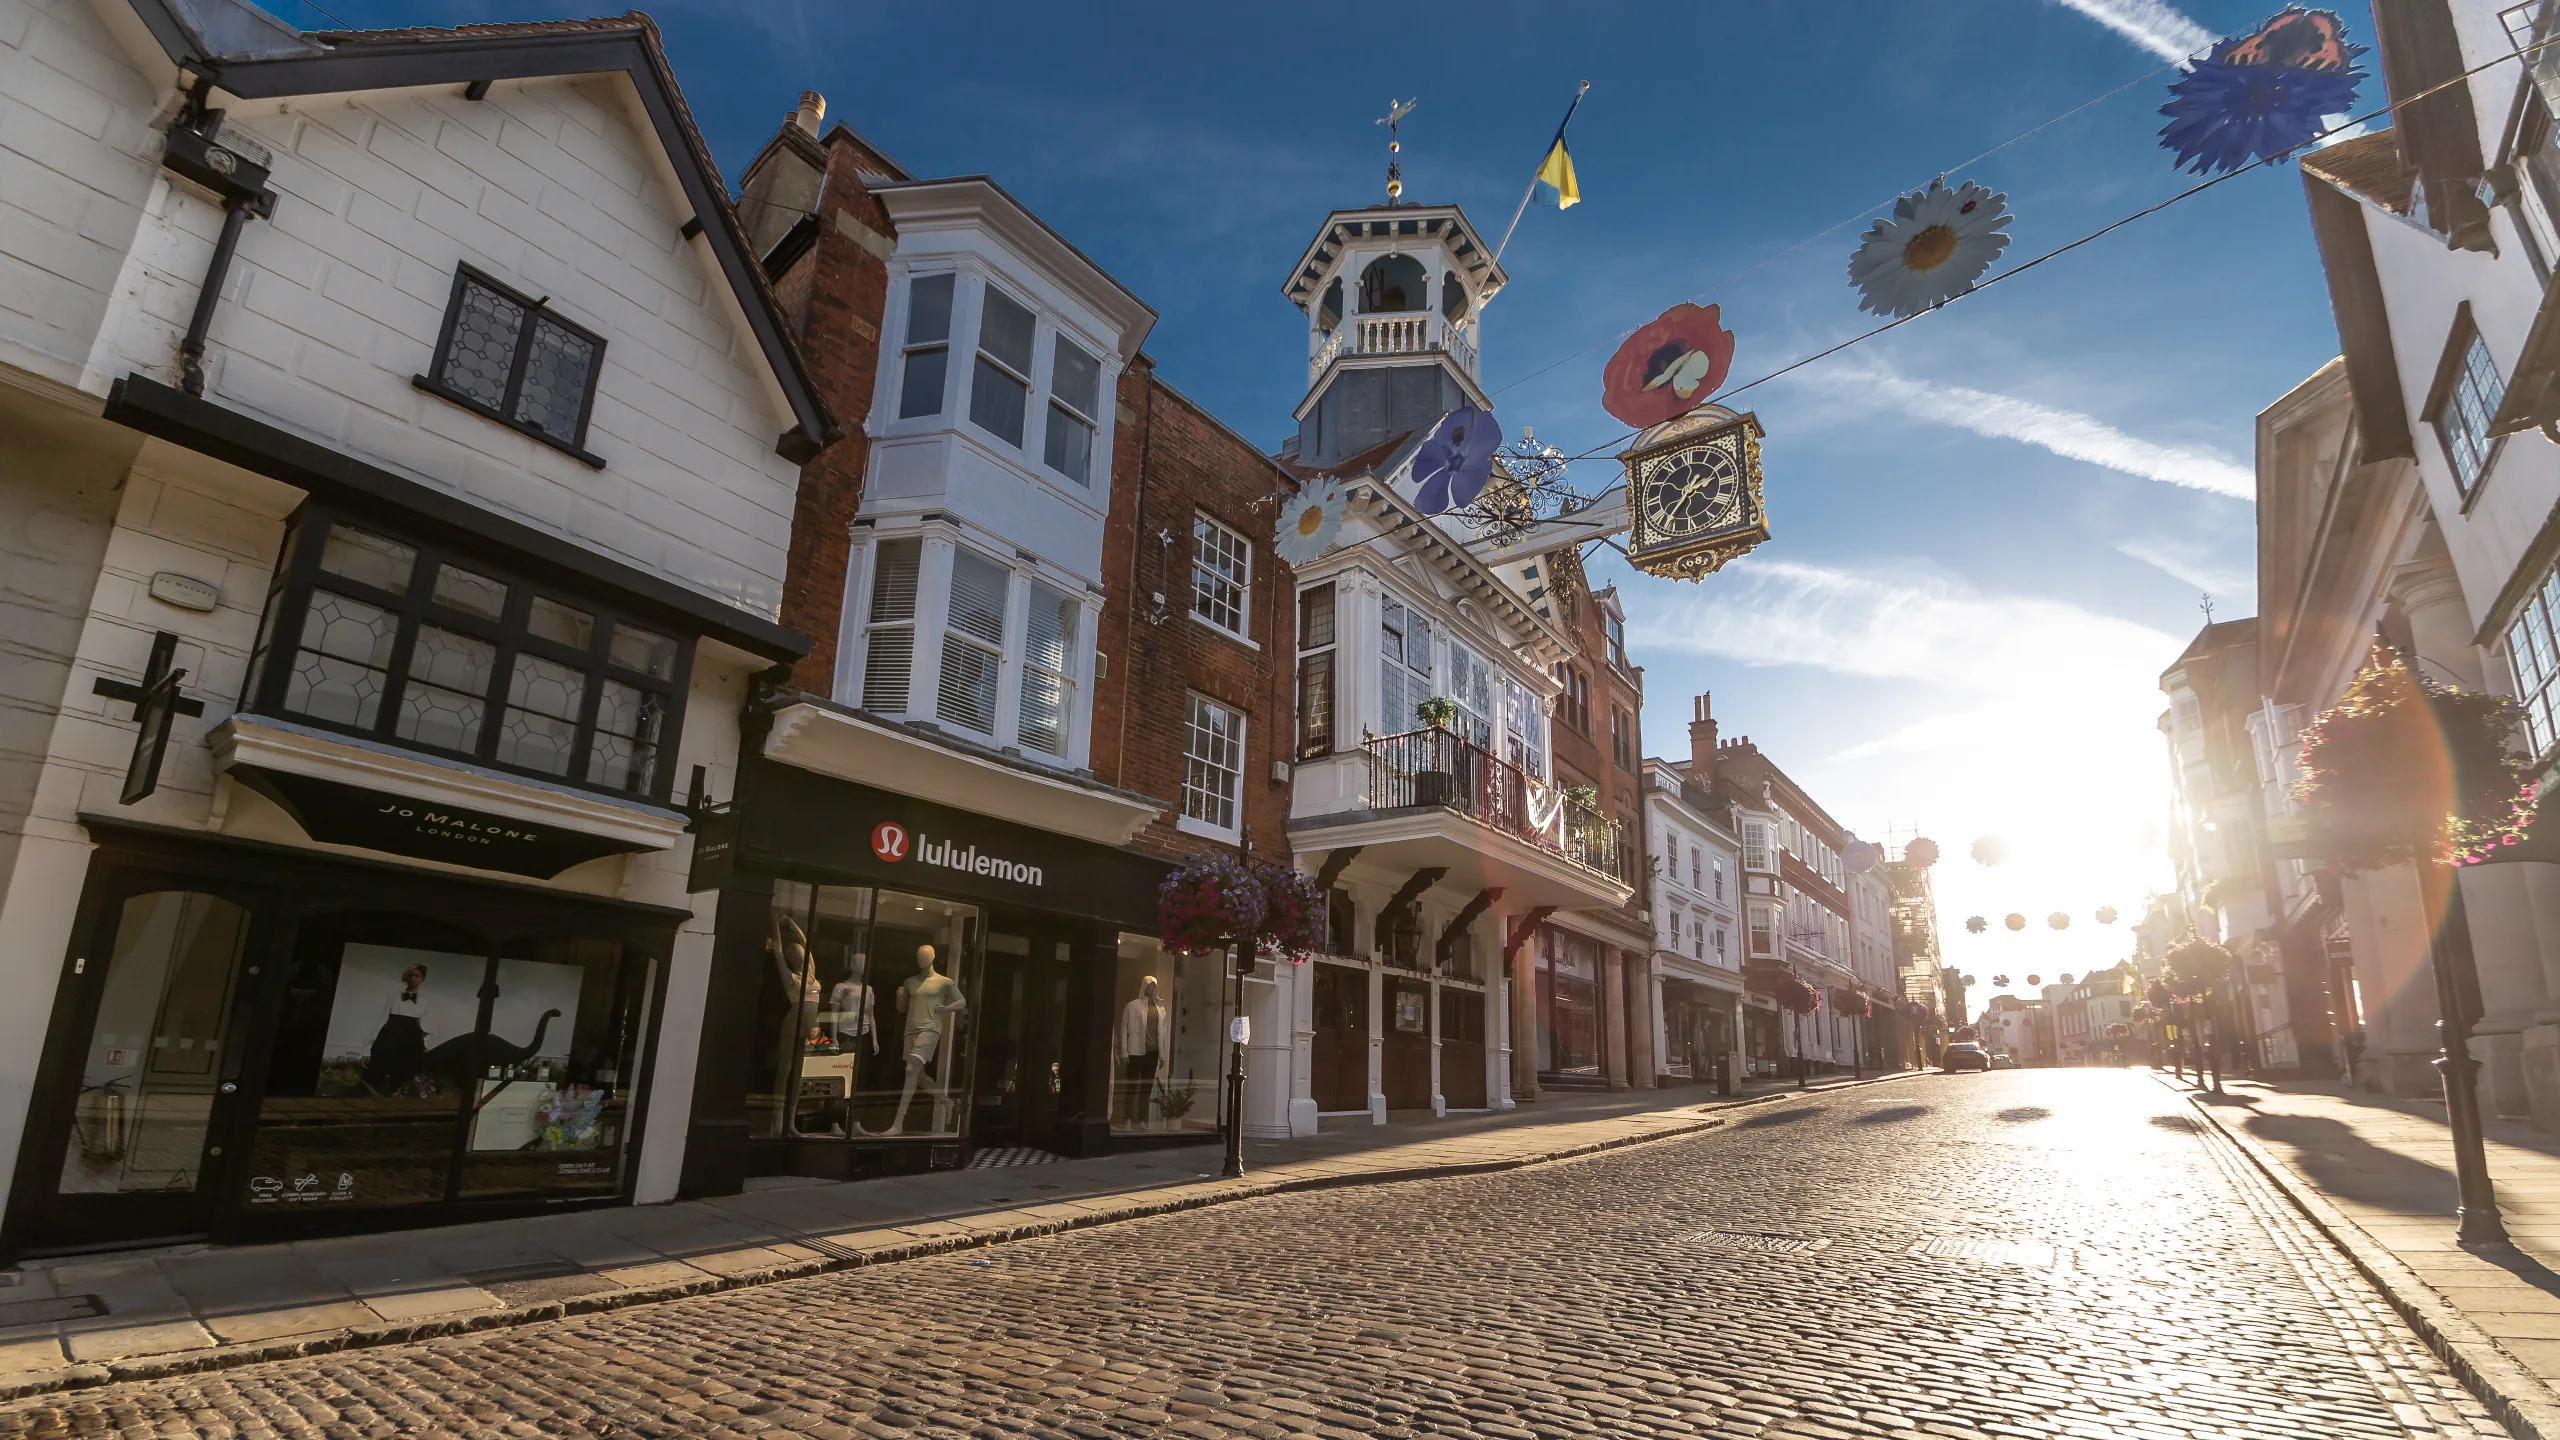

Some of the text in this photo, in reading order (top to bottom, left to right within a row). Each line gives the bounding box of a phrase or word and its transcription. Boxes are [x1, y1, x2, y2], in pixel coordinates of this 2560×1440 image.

[1681, 555, 1708, 570] 1683
[416, 826, 490, 845] LONDON
[916, 833, 1043, 887] lululemon
